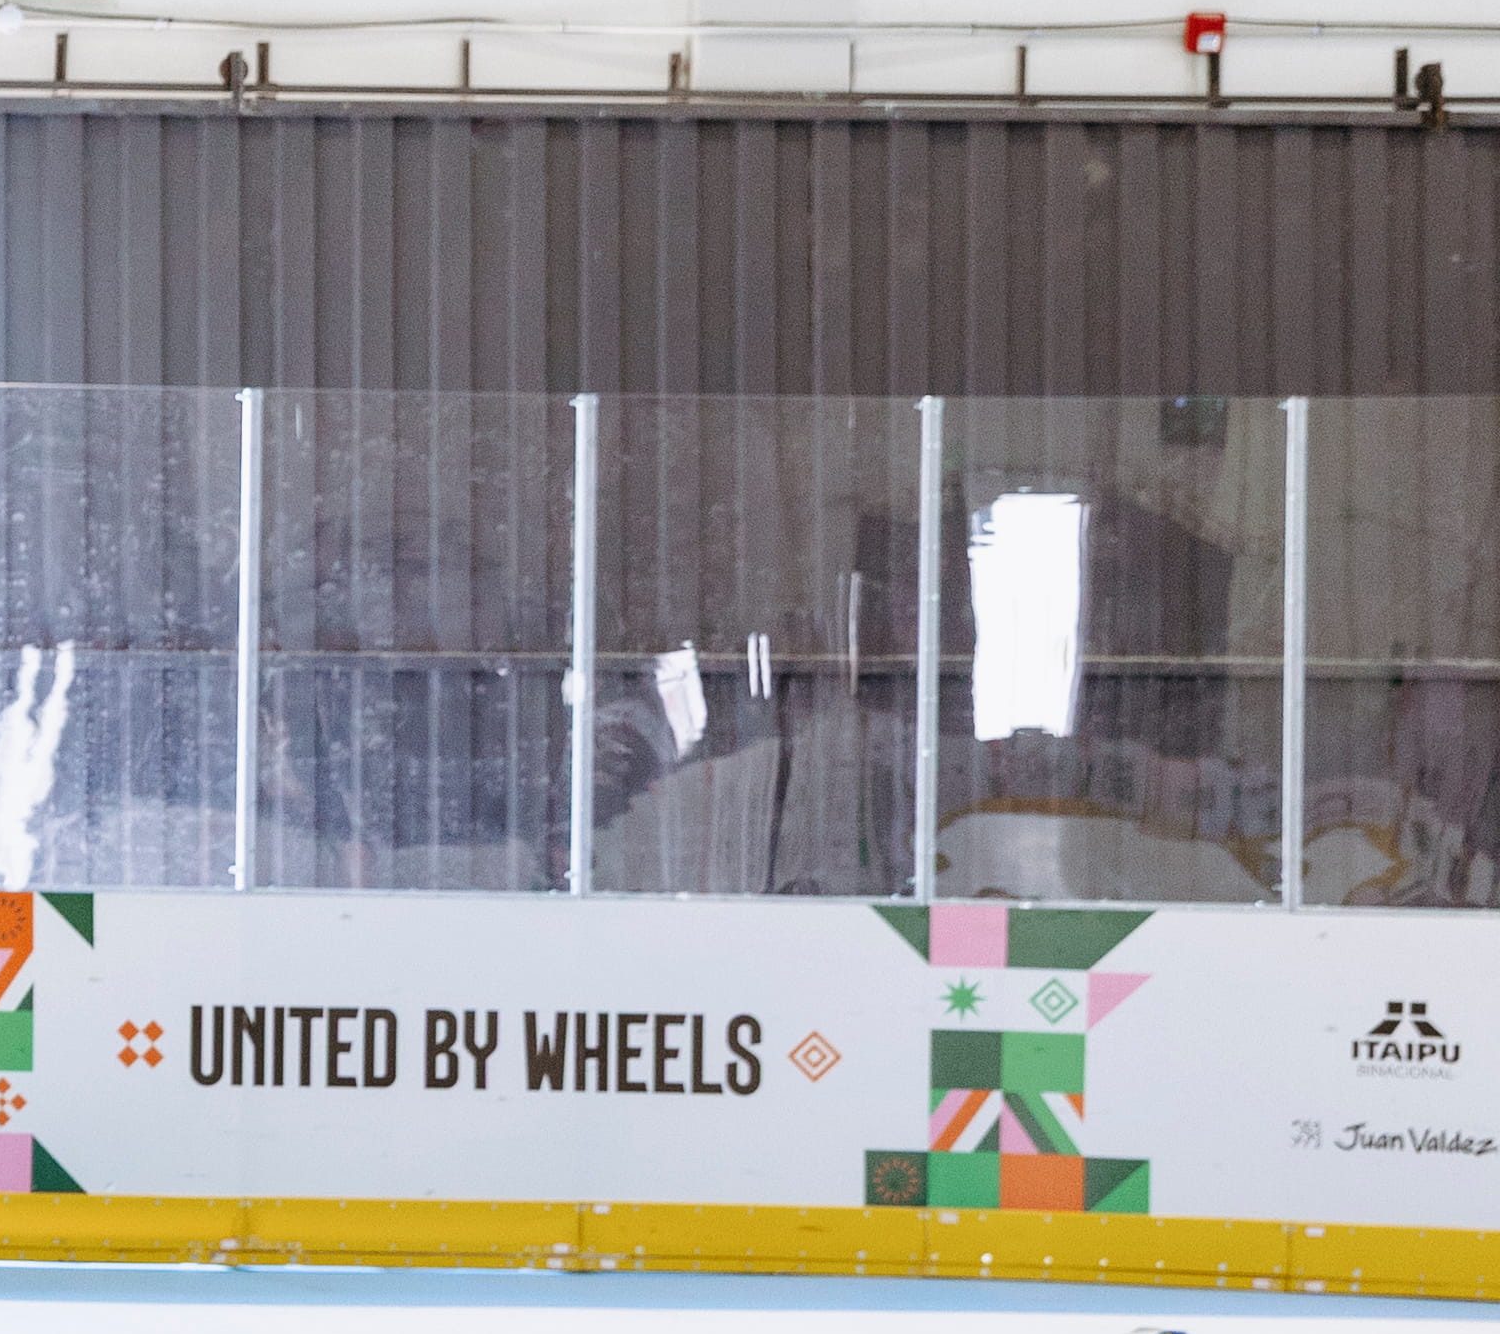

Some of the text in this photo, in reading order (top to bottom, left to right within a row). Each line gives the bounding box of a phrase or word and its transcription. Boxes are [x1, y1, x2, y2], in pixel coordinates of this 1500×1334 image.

[190, 1005, 763, 1097] UNITED BY WHEELS
[1352, 1040, 1460, 1063] ITAIPU
[1334, 1123, 1499, 1157] Juan Valdez
